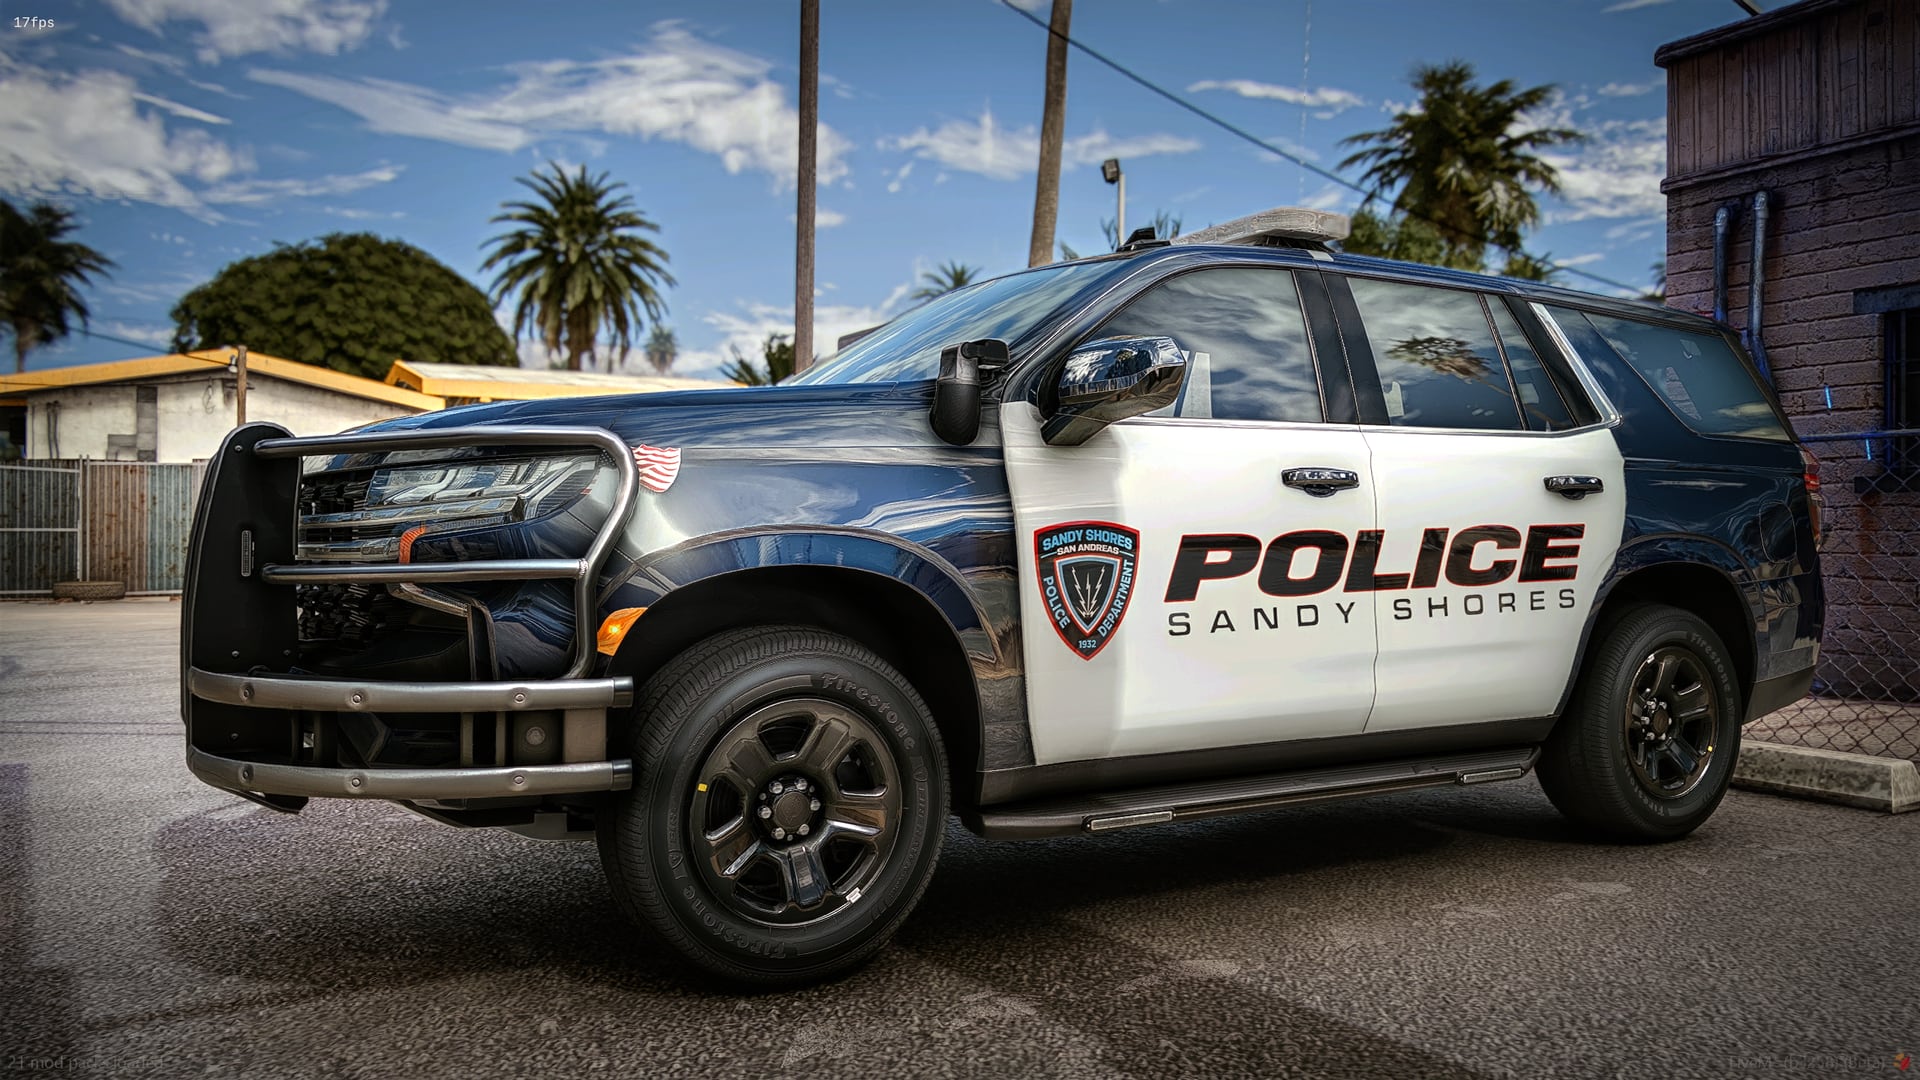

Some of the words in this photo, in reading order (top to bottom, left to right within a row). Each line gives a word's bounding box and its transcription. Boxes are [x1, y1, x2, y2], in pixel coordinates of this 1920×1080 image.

[1042, 529, 1084, 551] SANDY
[1085, 528, 1133, 550] SHORES
[1056, 543, 1077, 556] SAN
[1077, 543, 1120, 556] ANDREAS
[1163, 523, 1586, 603] POLICE
[1043, 575, 1071, 629] POLICE
[1097, 558, 1135, 638] DEPARTMENT
[1167, 601, 1356, 637] SANDY
[1392, 588, 1576, 621] SHORES
[1077, 639, 1097, 649] 1932
[821, 673, 916, 750] Firestone
